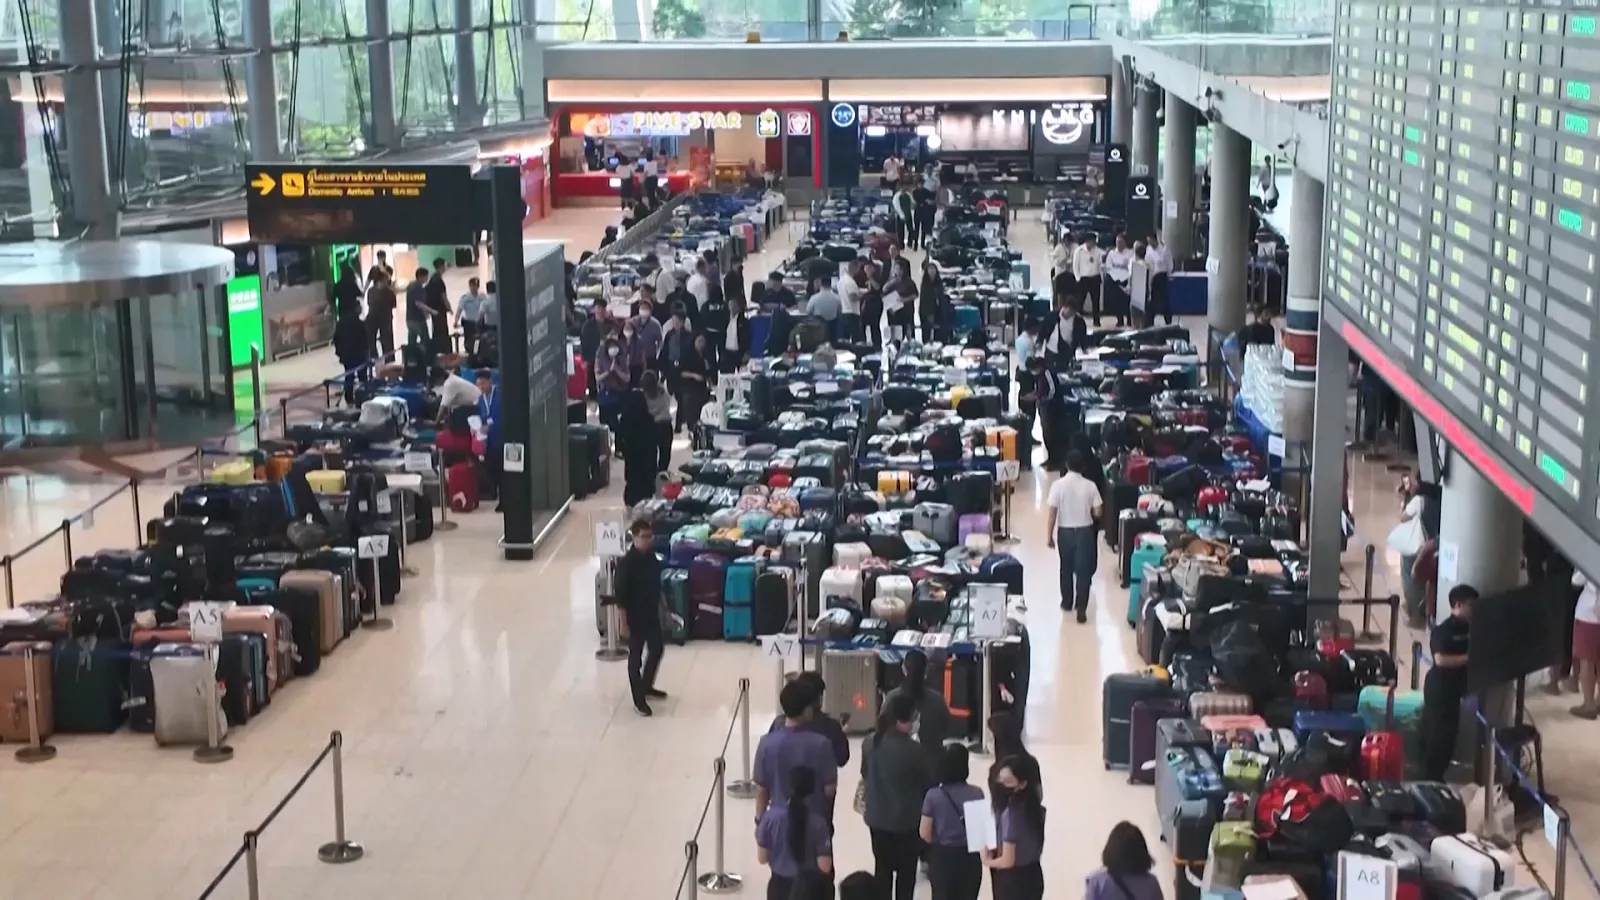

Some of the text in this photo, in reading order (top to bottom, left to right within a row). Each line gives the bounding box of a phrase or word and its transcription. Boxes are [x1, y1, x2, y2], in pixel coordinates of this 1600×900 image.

[633, 111, 742, 129] FIVE STAR
[346, 187, 375, 196] Arrivals
[602, 529, 617, 540] A6
[363, 539, 384, 555] A5
[193, 608, 218, 625] A5
[981, 606, 998, 622] A7
[768, 639, 794, 657] A7
[1356, 867, 1380, 886] A8
